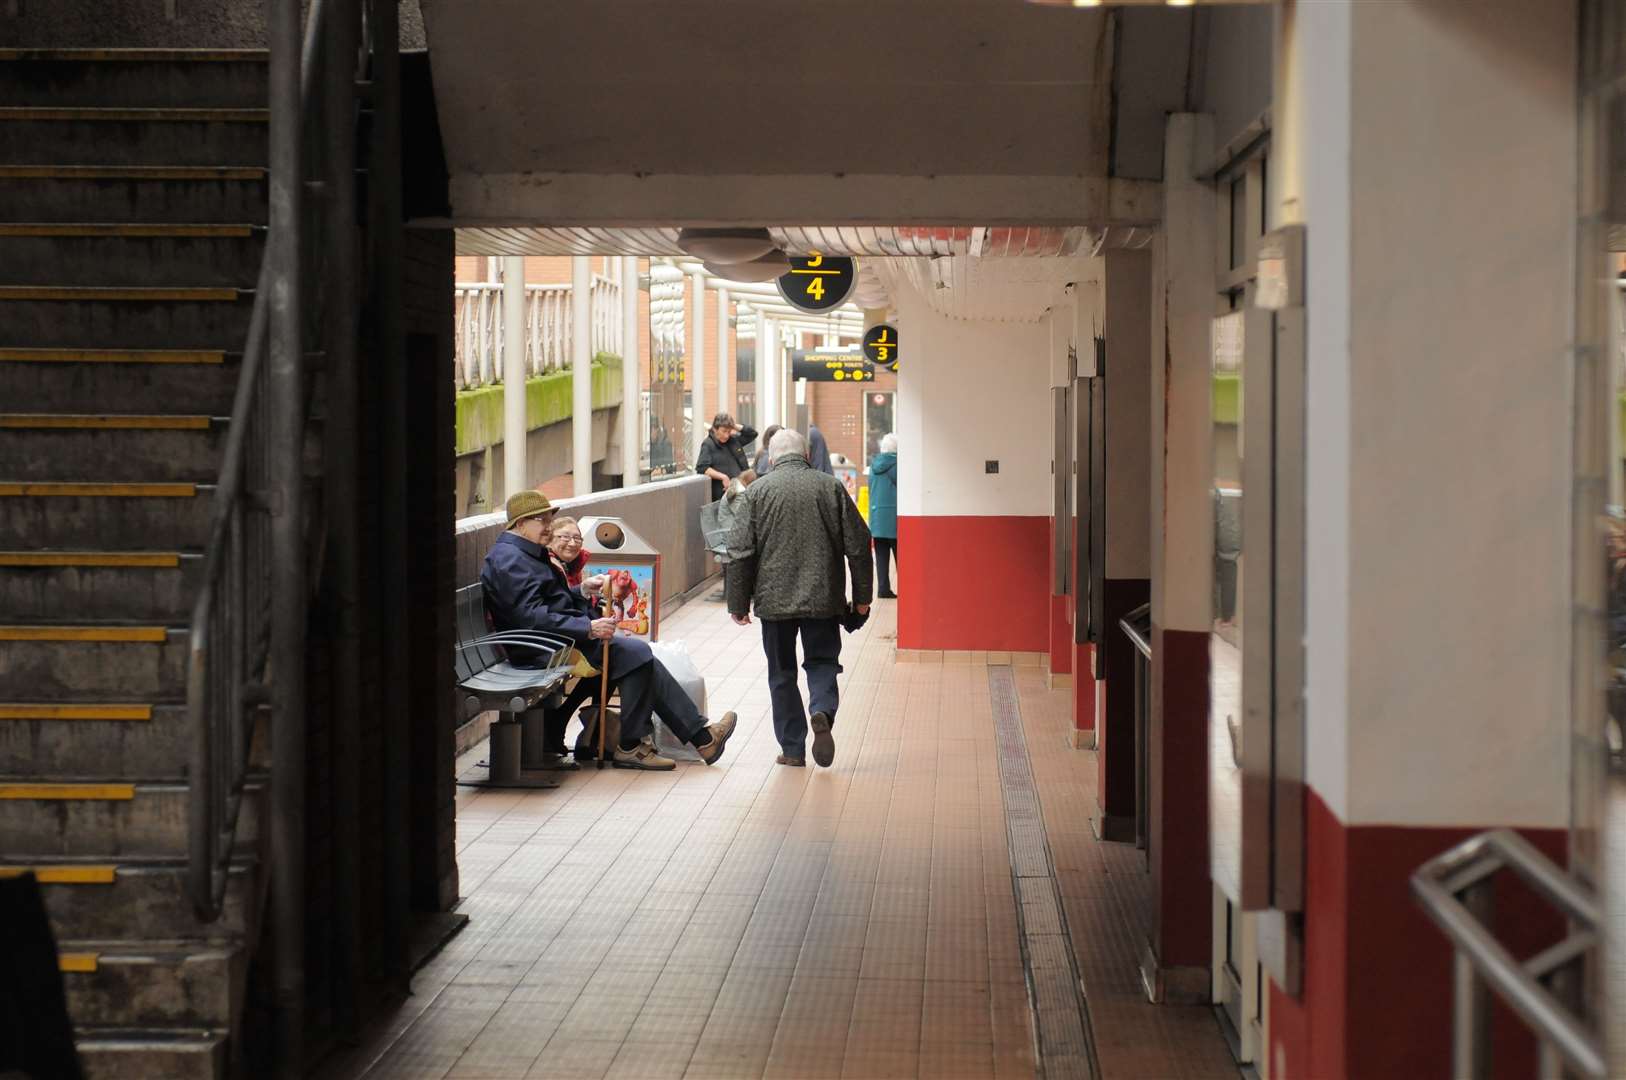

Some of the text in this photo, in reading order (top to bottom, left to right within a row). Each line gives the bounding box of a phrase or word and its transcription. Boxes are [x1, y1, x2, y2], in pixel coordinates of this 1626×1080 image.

[806, 277, 825, 301] 4
[877, 329, 887, 343] J
[877, 347, 888, 361] 3
